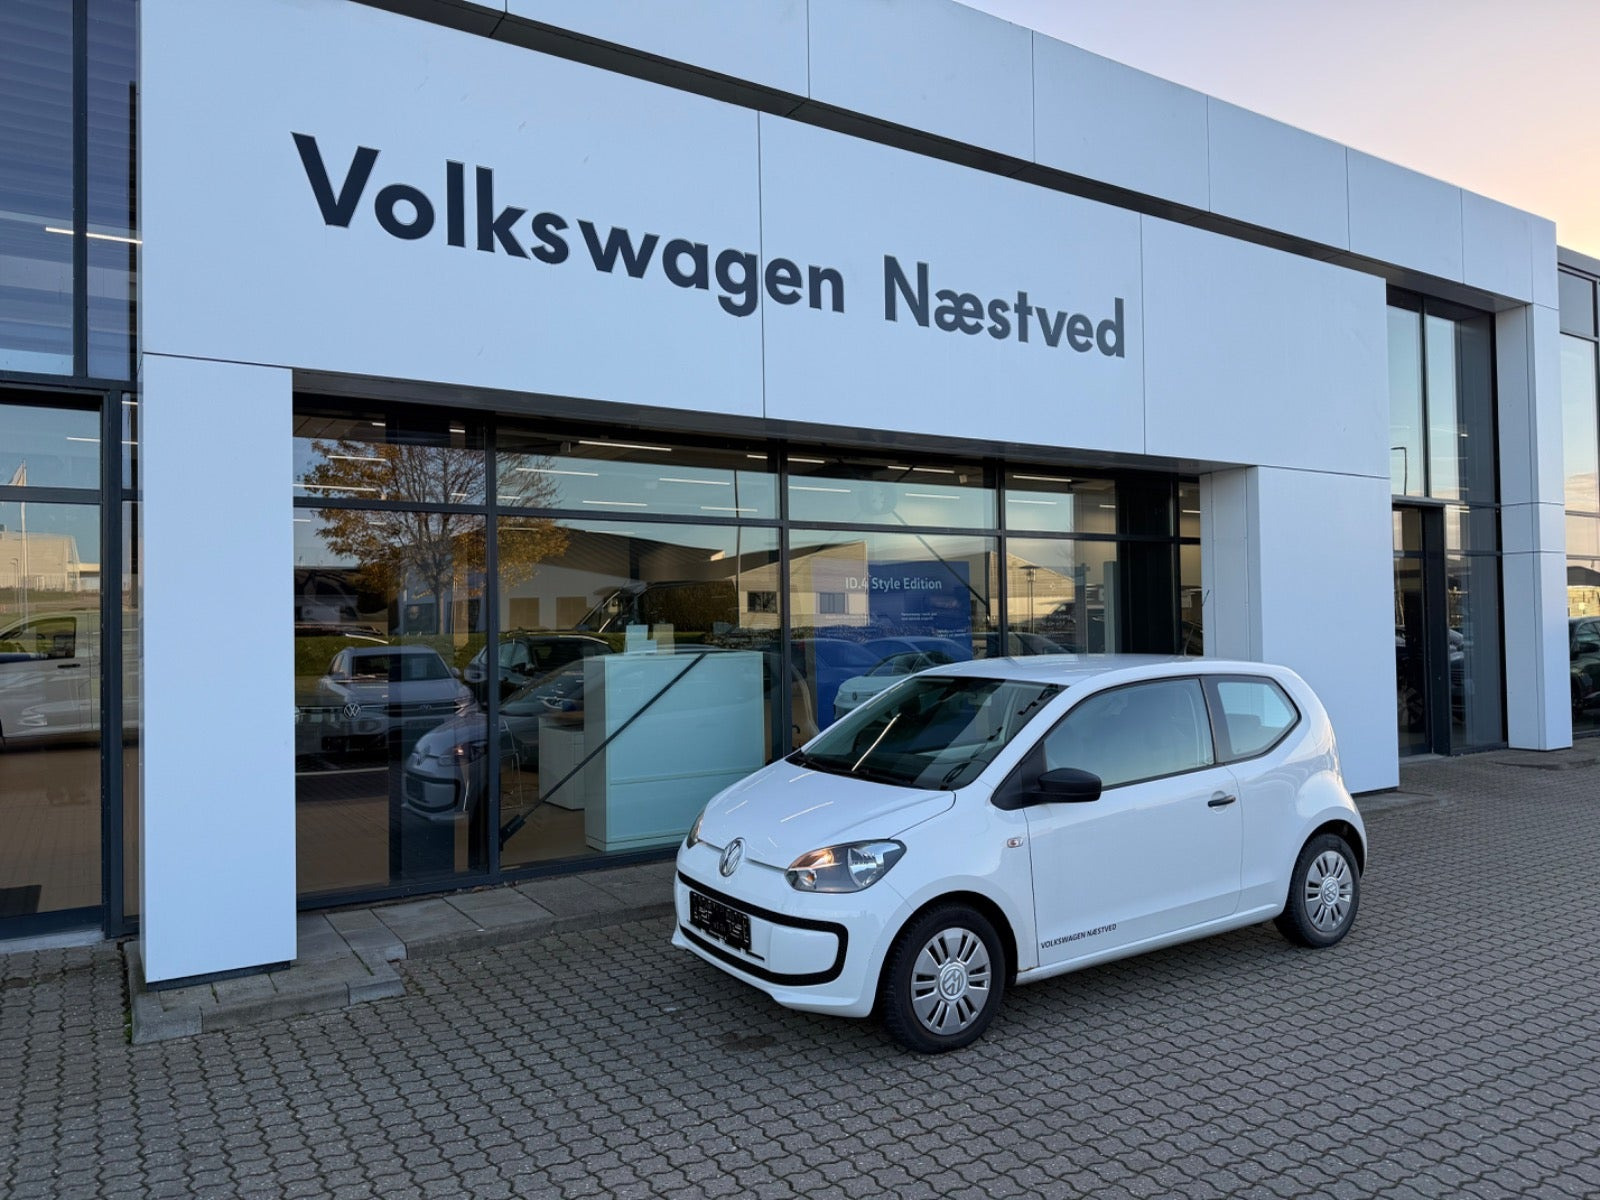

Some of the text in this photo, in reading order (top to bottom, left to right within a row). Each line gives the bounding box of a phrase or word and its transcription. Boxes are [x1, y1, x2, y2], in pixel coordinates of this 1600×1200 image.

[291, 131, 1125, 359] Volkswagen Næstved
[845, 577, 942, 592] ID.4 Style Edition
[1040, 923, 1117, 949] VOLKSWAGEN NÆSTVED
